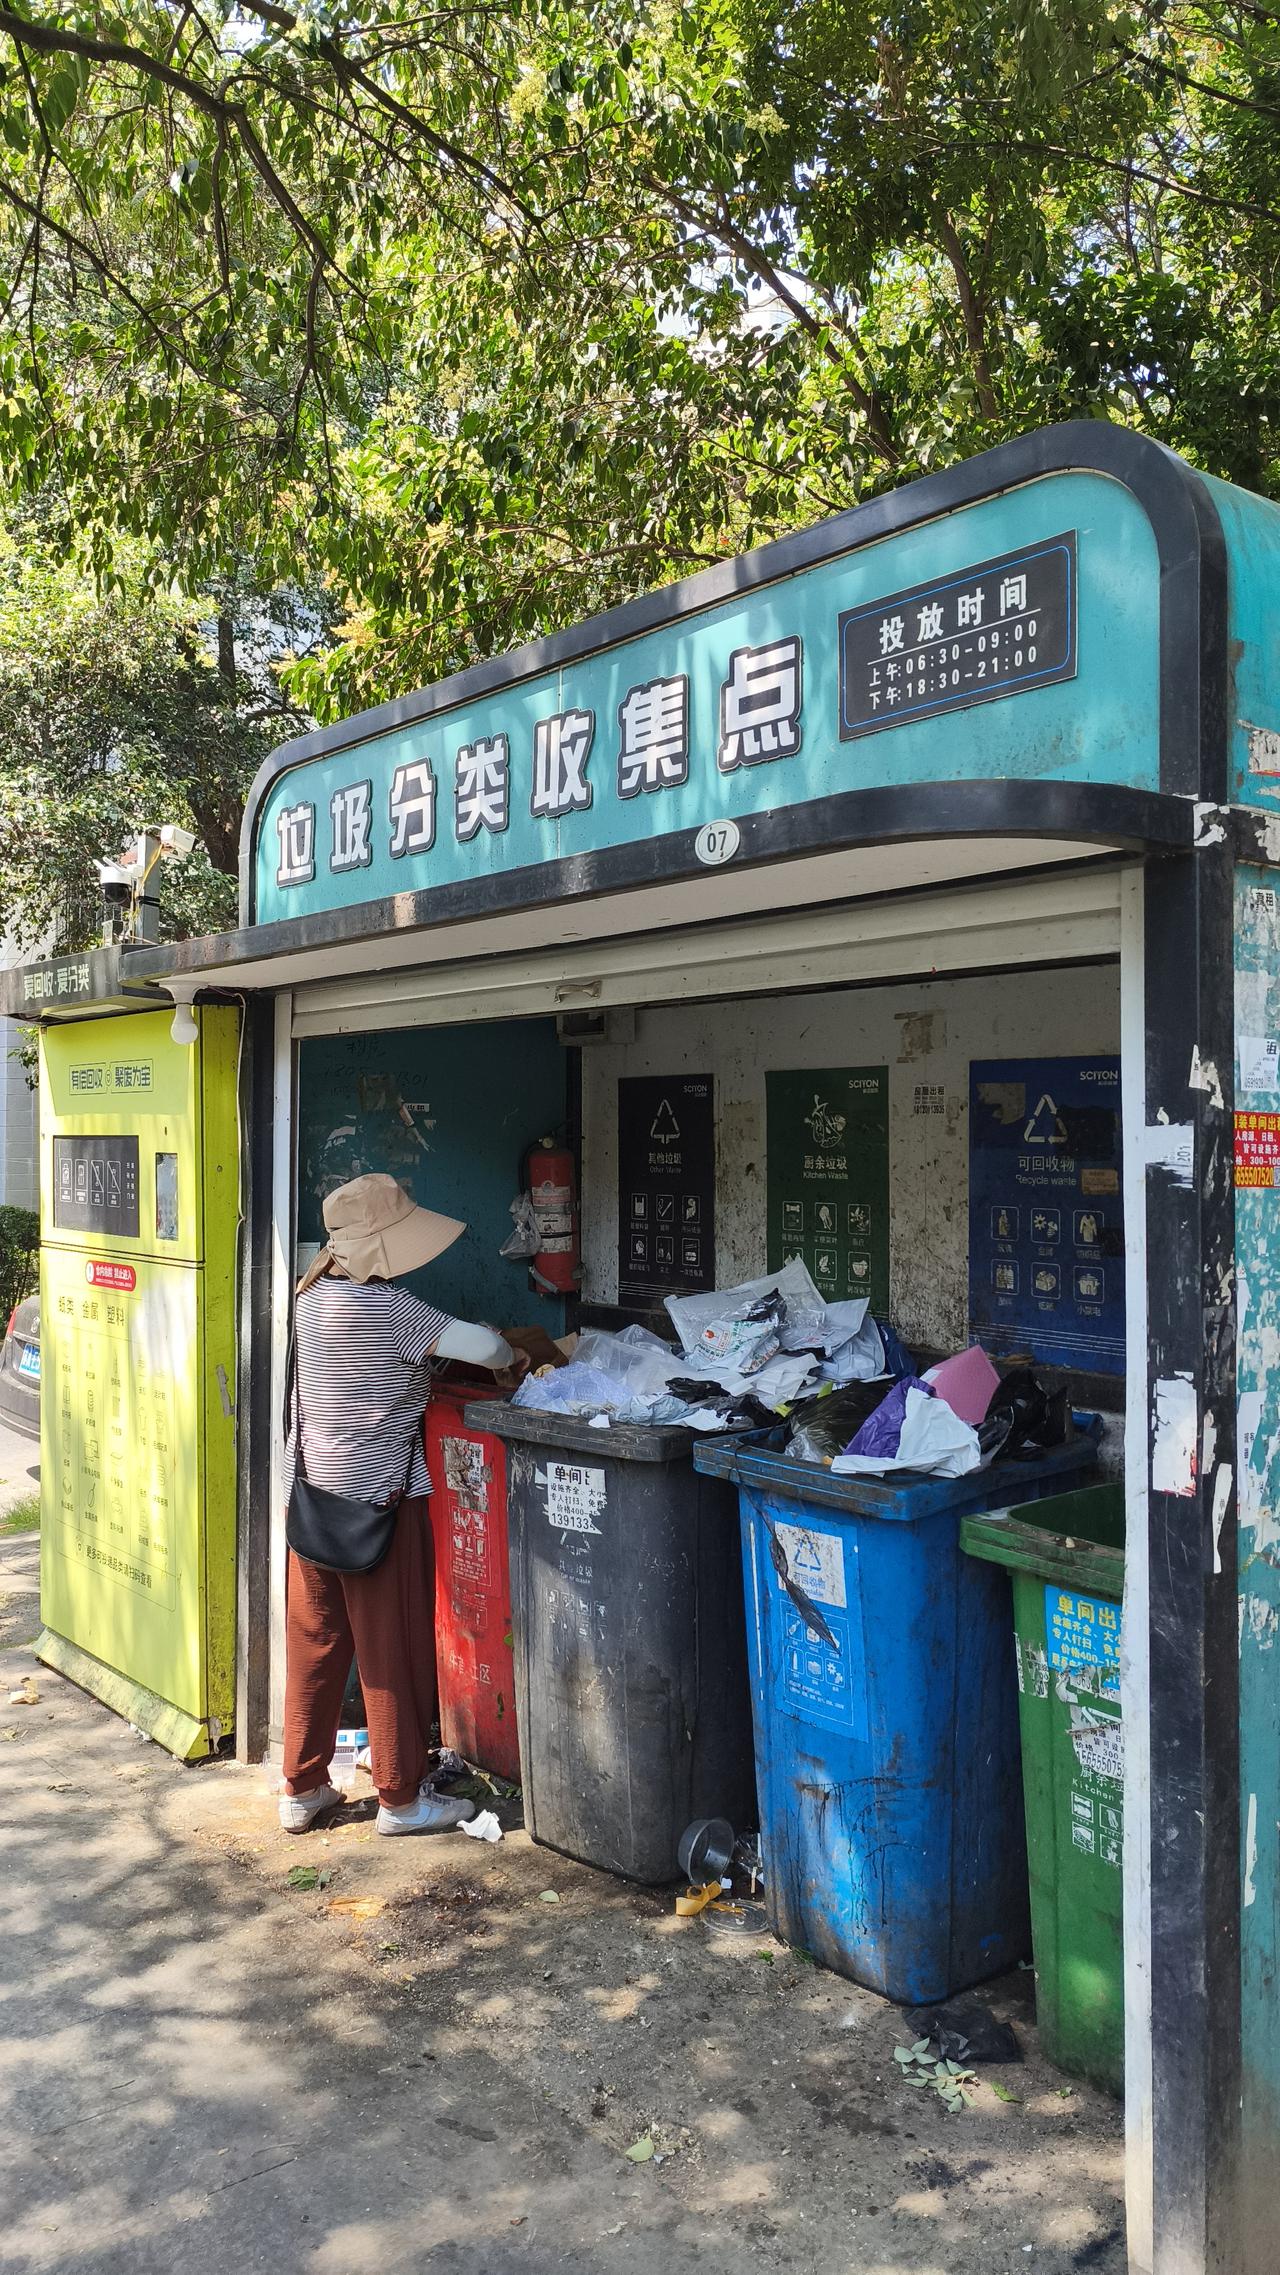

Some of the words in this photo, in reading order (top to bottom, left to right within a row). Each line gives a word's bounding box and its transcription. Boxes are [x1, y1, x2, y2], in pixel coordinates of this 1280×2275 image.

[879, 574, 1027, 654] 投放时间
[276, 634, 802, 888] 垃圾分类收集点
[706, 830, 728, 855] 07
[1080, 1070, 1118, 1081] SCIYON
[848, 1079, 879, 1089] SCIYON
[804, 1155, 848, 1170] 厨余垃圾
[1017, 1155, 1075, 1172] 可回收物
[803, 1171, 827, 1180] Kitchen
[1015, 1174, 1049, 1187] Recycle
[1051, 1175, 1077, 1186] waste
[1072, 1778, 1114, 1801] Kitchen
